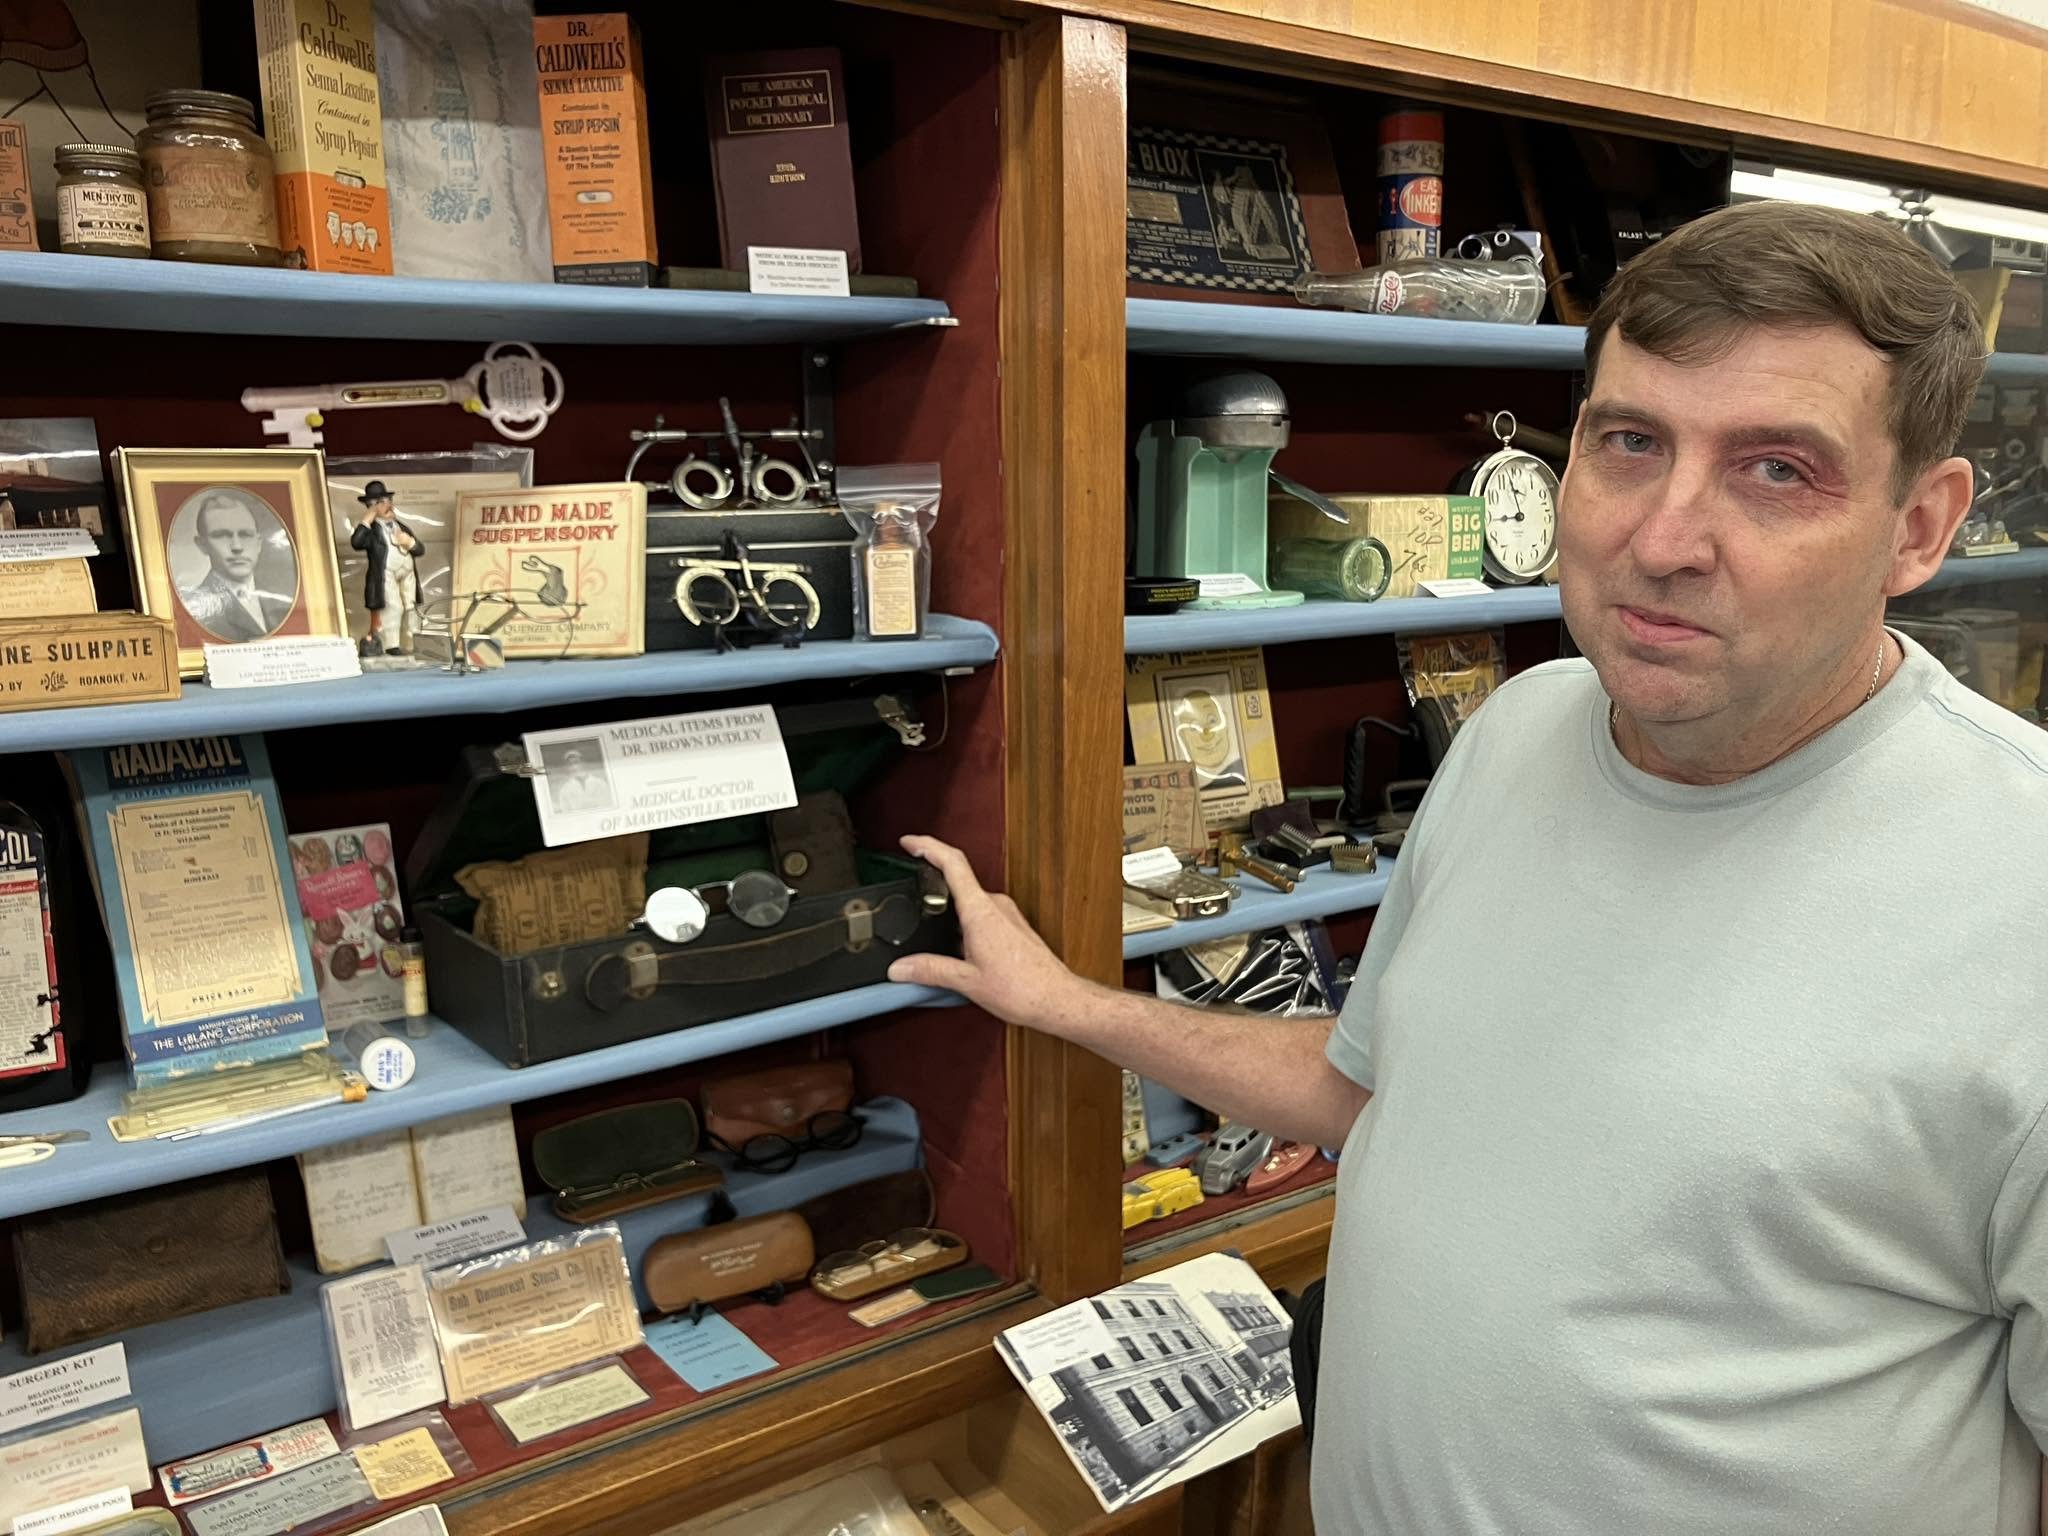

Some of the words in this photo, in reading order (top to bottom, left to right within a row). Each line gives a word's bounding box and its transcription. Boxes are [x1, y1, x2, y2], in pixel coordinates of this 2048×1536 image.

[325, 0, 350, 32] Dr.
[567, 21, 594, 37] DR.
[300, 22, 377, 73] Caldwell's
[536, 36, 626, 73] CALDWELL'S
[305, 63, 339, 94] Senna
[340, 72, 376, 105] Laxative
[730, 95, 774, 110] POCKET
[776, 92, 829, 107] MEDICAL
[747, 110, 816, 127] DICTIONARY
[314, 121, 347, 156] Syrup
[347, 130, 379, 160] Pepsin
[1138, 142, 1193, 177] BLOX
[1487, 490, 1499, 505] 10
[481, 504, 544, 525] HAND
[551, 502, 614, 522] MADE
[1452, 514, 1480, 532] BIG
[472, 525, 620, 546] SUSPENSORY
[1451, 533, 1480, 553] BEN
[47, 638, 153, 663] SULHPATE
[79, 674, 127, 686] ROANOKE,
[132, 672, 148, 682] VA.
[610, 721, 680, 742] MEDICAL
[680, 714, 723, 734] ITEMS
[725, 712, 766, 728] FROM
[621, 743, 646, 758] DR.
[650, 733, 704, 753] BROWN
[706, 728, 764, 748] DUDLEY
[631, 788, 696, 810] MEDICAL
[698, 779, 755, 800] DOCTOR
[599, 816, 624, 833] OF
[729, 791, 790, 812] VIRGINIA
[153, 1037, 175, 1051] THE
[227, 1011, 305, 1036] CORPORATION
[8, 1365, 70, 1390] SURGERY
[73, 1356, 96, 1371] KIT
